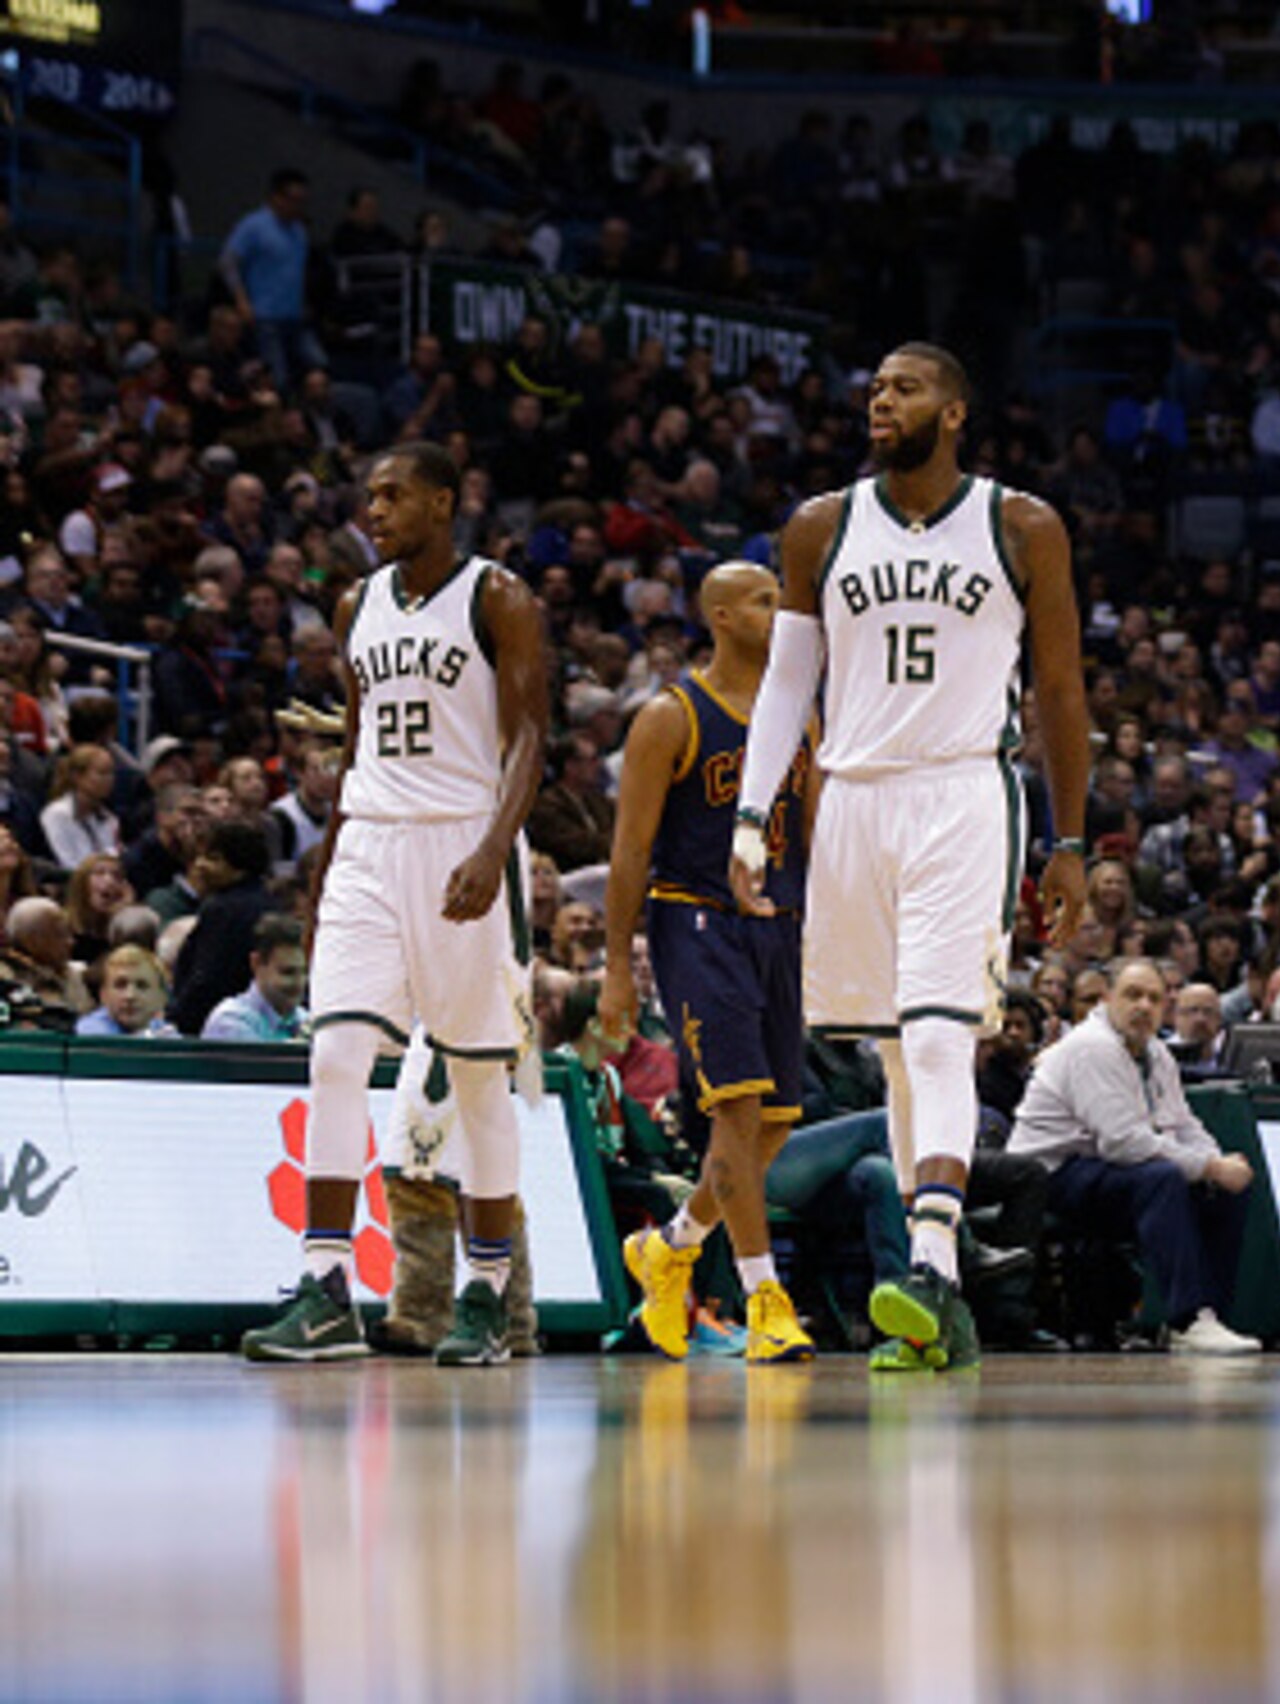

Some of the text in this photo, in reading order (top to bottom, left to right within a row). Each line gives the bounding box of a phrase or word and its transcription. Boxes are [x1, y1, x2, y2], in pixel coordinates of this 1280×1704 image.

[452, 280, 526, 344] OWN
[624, 302, 689, 371] THE
[839, 559, 994, 616] BUCKS
[353, 637, 469, 694] BUCKS
[885, 623, 936, 684] 15
[376, 700, 433, 758] 22
